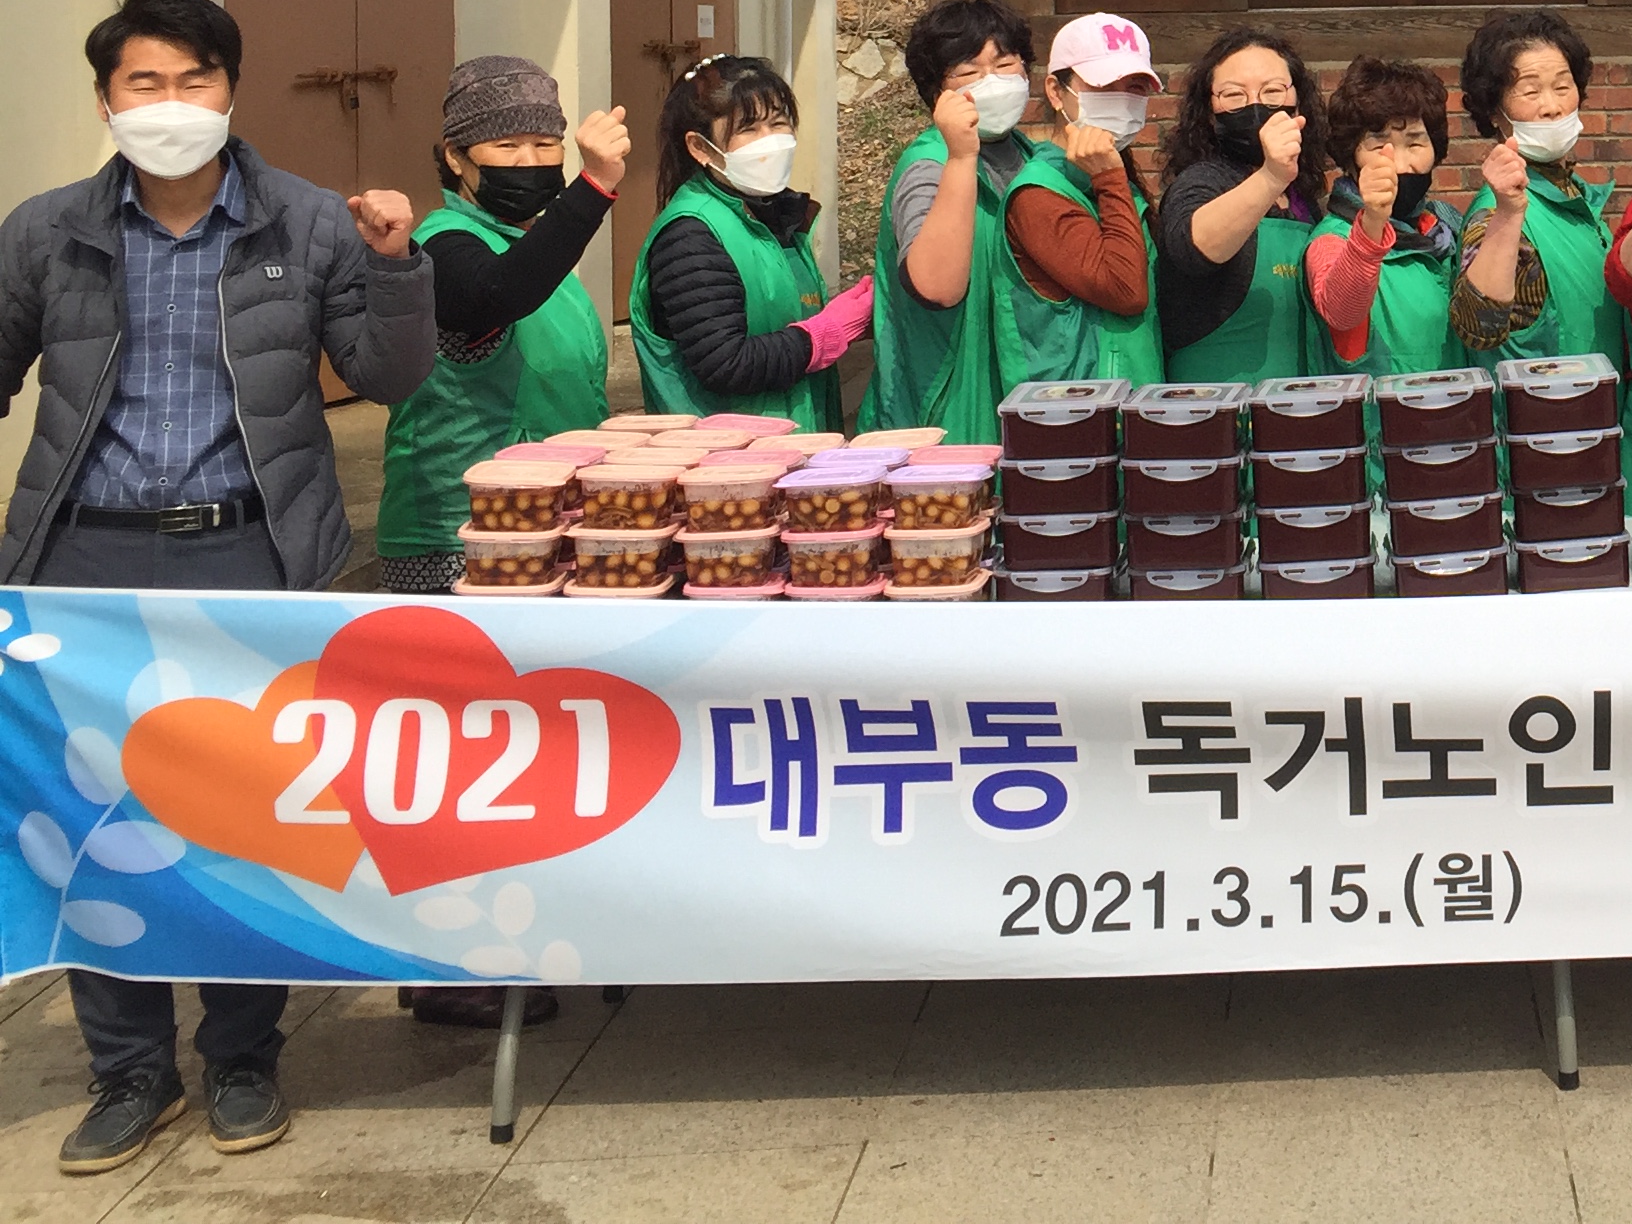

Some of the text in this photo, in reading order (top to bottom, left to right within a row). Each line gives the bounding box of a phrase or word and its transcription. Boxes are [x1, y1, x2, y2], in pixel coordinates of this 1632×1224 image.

[1102, 24, 1139, 52] M
[272, 698, 610, 826] 2021
[711, 697, 1079, 837] 대부동
[1133, 690, 1614, 821] 독거노인
[1000, 851, 1523, 937] 2021.3.15.(월)
